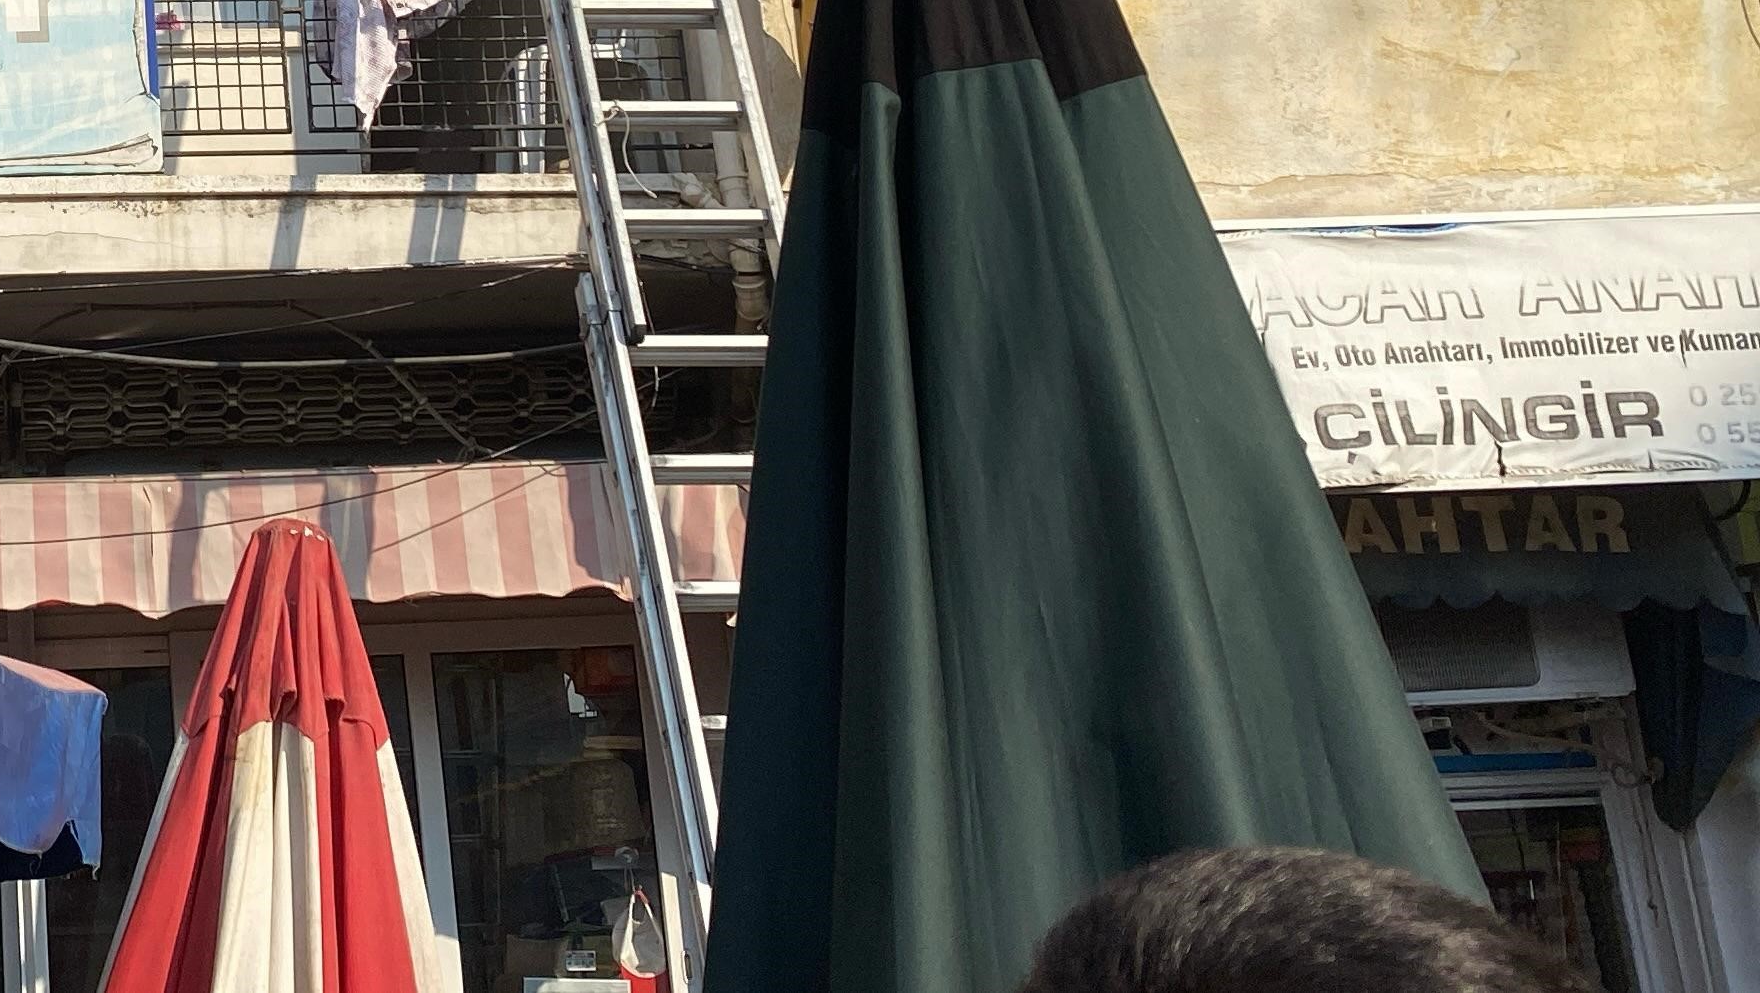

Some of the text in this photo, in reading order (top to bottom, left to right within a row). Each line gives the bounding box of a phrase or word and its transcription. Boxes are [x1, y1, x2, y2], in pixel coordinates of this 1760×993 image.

[1290, 346, 1331, 372] Ev,
[1334, 343, 1377, 368] Oto
[1499, 332, 1640, 360] Immobilizer
[1646, 334, 1676, 354] ve
[1314, 380, 1664, 464] ÇİLİNGİR
